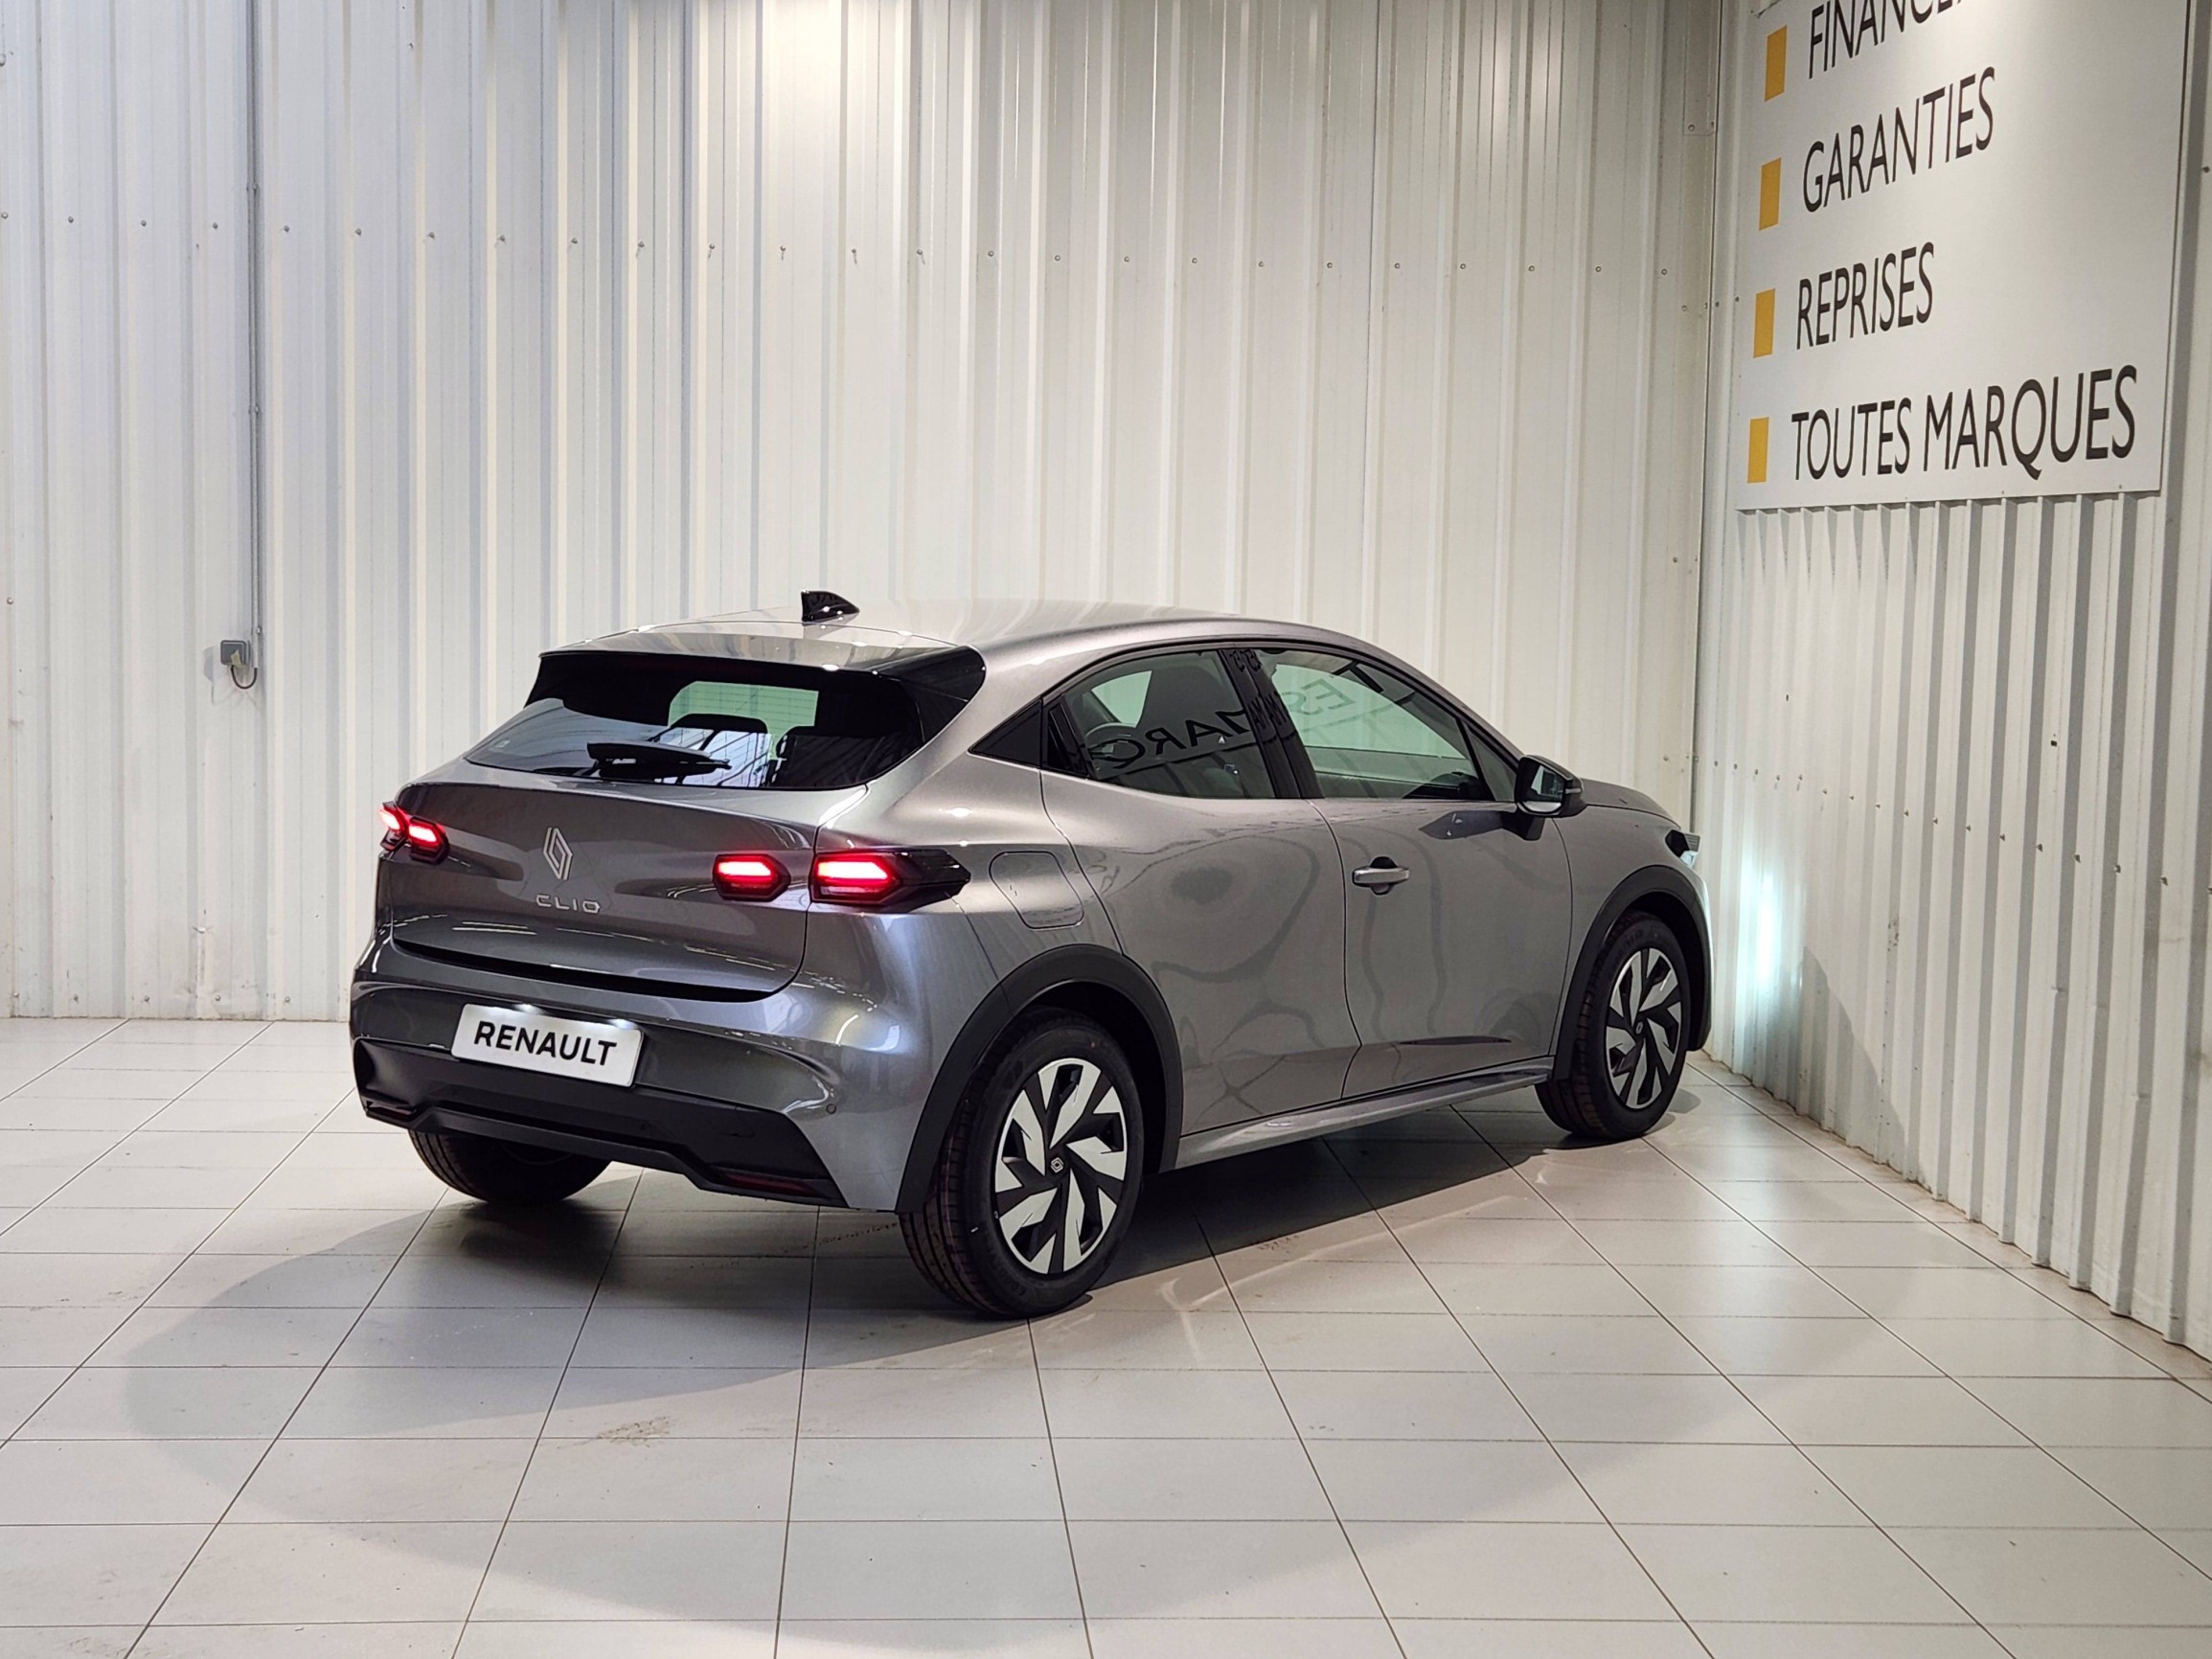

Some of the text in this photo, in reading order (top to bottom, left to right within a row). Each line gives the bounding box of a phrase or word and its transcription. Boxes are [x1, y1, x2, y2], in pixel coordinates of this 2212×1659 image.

[1803, 66, 1995, 213] GARANTIES
[1796, 241, 1935, 350] REPRISES
[1791, 365, 2137, 481] TOUTES MARQUES
[536, 894, 601, 914] CLIO
[473, 1020, 618, 1066] RENAULT
